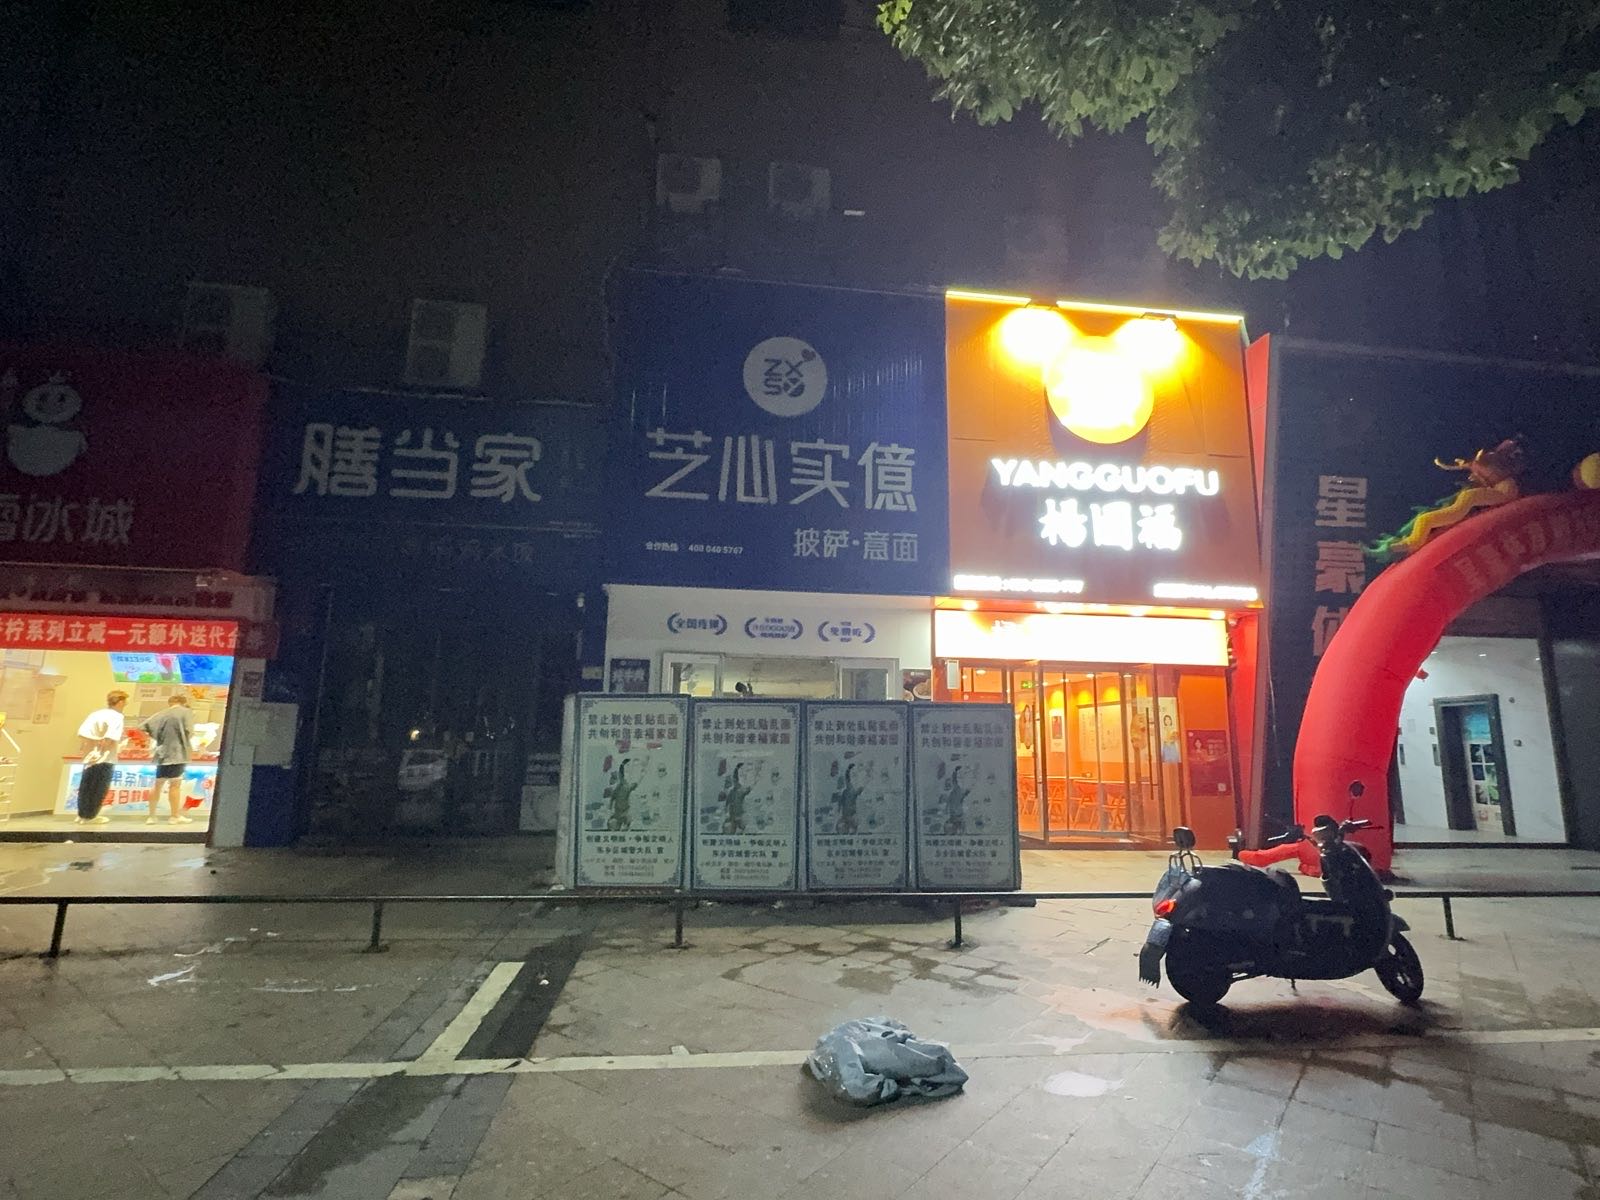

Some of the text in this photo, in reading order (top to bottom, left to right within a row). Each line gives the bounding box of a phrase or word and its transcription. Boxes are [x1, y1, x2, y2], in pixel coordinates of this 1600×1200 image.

[292, 422, 542, 503] 膳当家
[991, 459, 1220, 496] YANGGUOFU
[0, 618, 267, 650] 柠系列立减一元额外送代金
